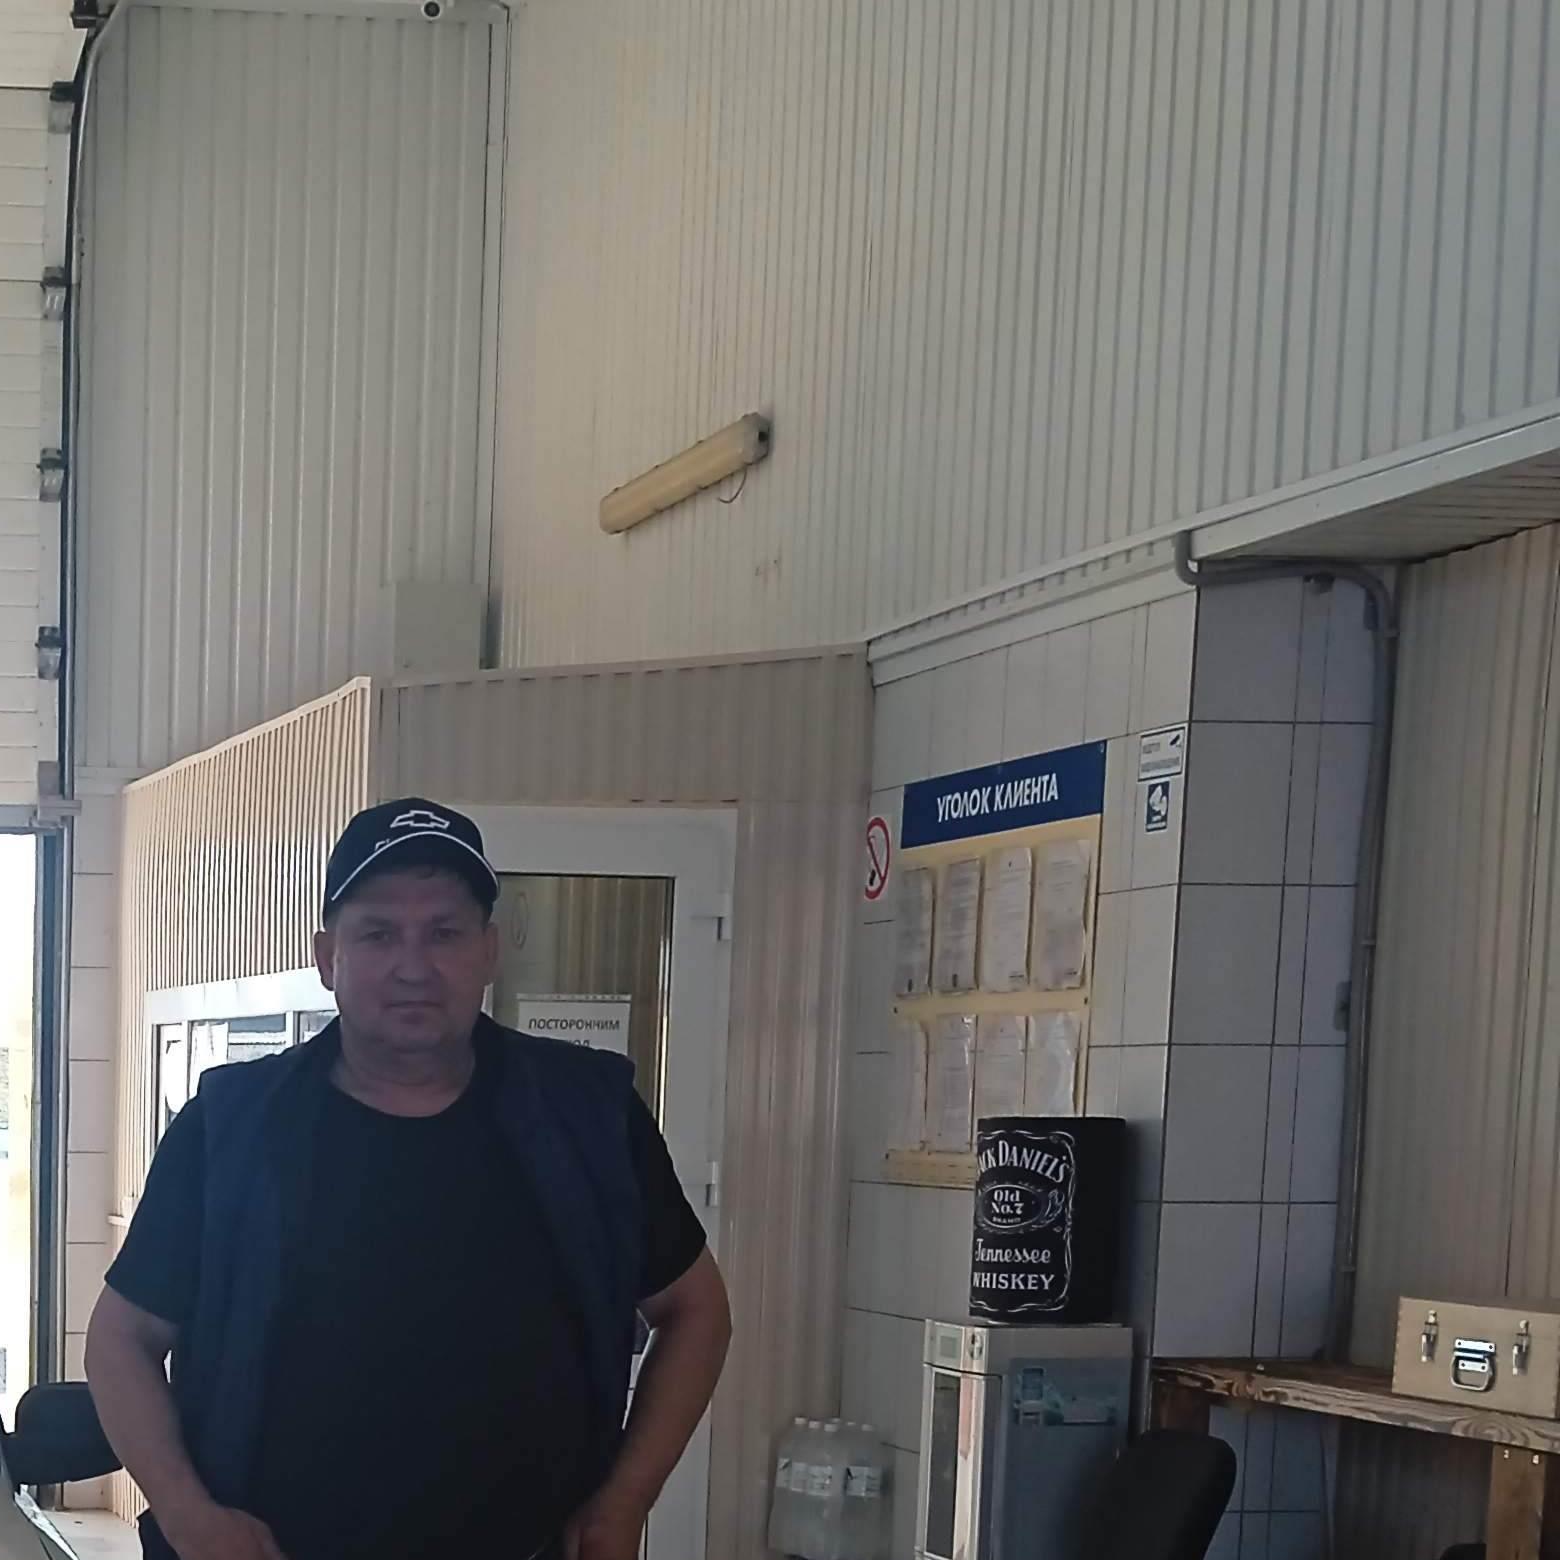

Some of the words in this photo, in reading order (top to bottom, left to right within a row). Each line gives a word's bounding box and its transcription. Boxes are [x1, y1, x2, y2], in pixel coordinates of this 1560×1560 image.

[936, 786, 992, 822] УГОЛОК
[993, 772, 1059, 812] КЛИЕНТА
[528, 1018, 620, 1031] ПОСТОРОННИМ
[994, 1189, 1020, 1202] Old
[975, 1238, 1051, 1263] Tennessee
[972, 1271, 1055, 1290] WHISKEY
